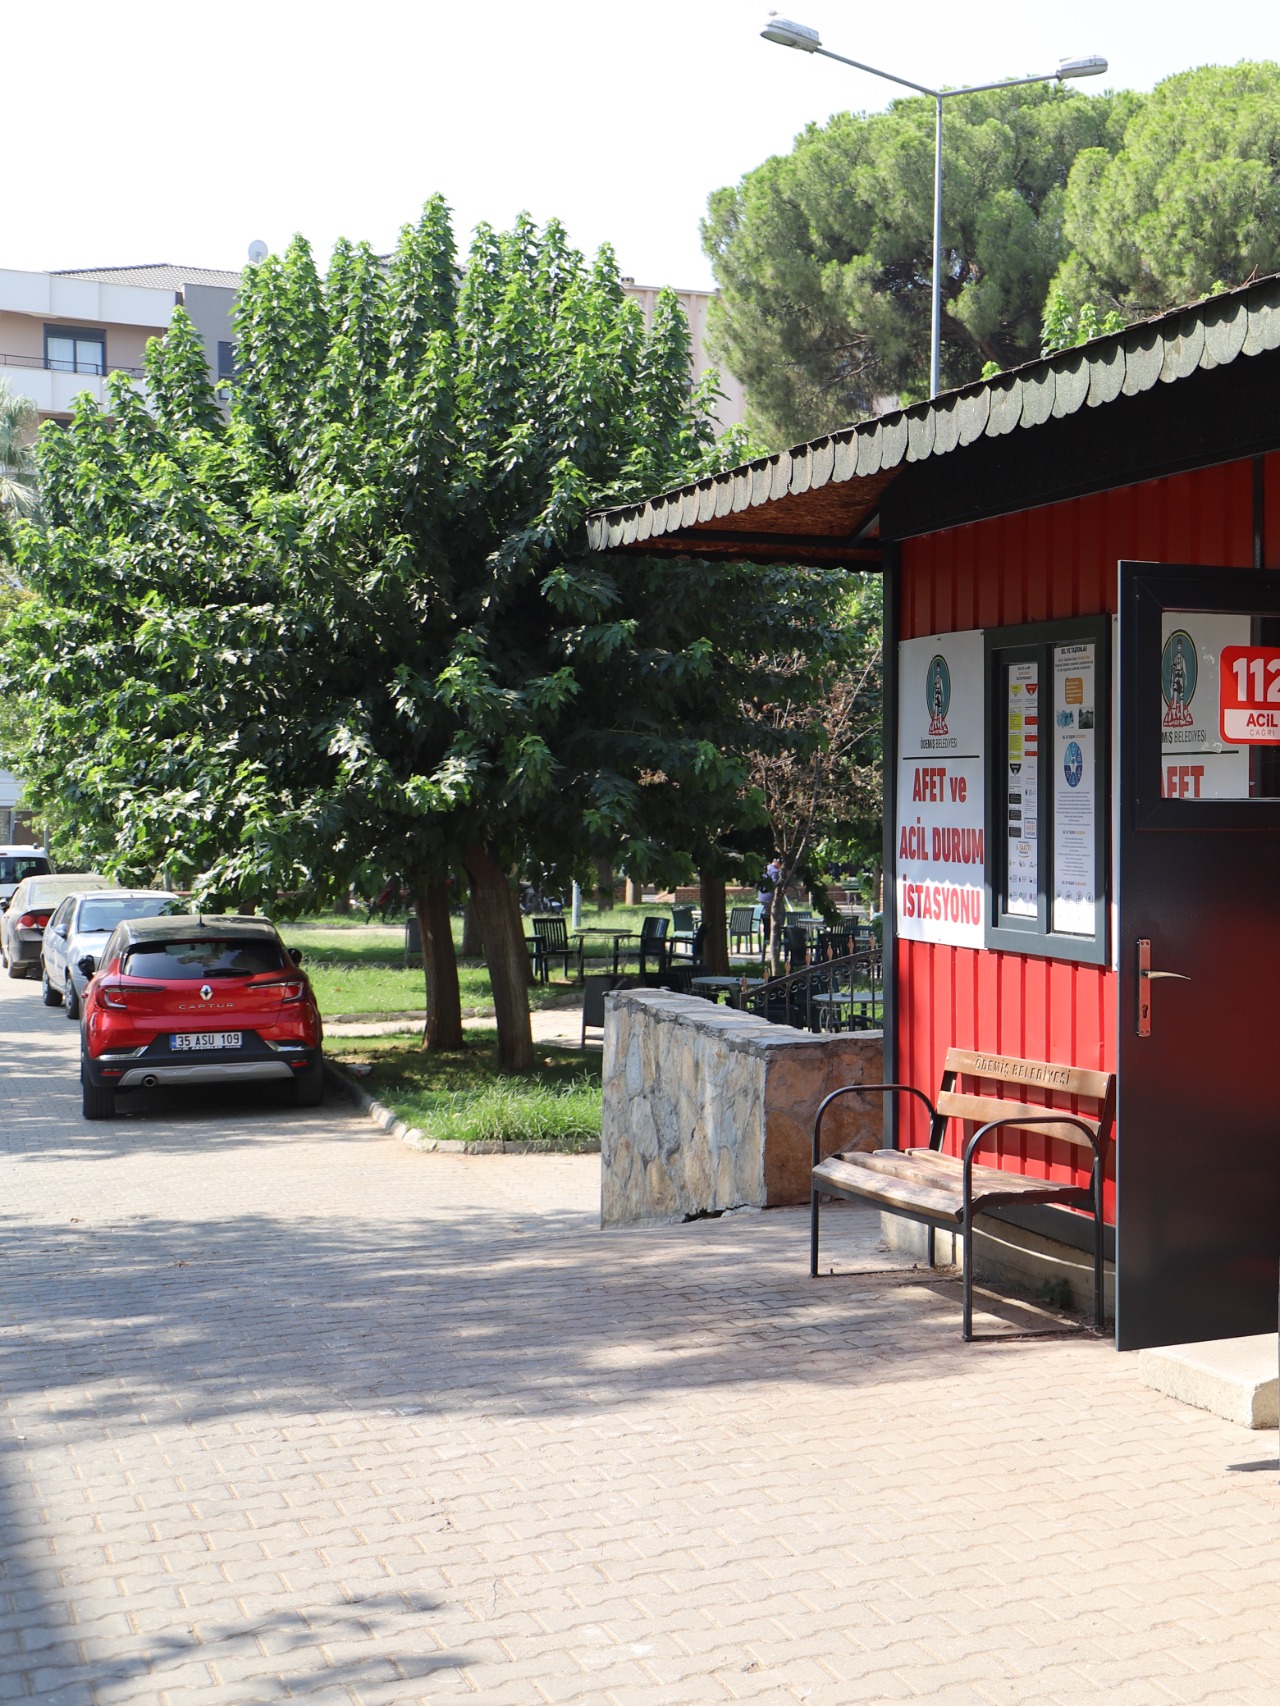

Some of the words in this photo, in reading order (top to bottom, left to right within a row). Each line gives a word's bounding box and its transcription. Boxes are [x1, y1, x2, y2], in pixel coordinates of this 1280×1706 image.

[1161, 731, 1173, 745] MİŞ
[912, 767, 946, 802] AFET
[949, 776, 967, 803] ve
[1161, 765, 1205, 798] FET
[899, 816, 928, 861] ACİL
[932, 827, 984, 865] DURUM
[902, 873, 980, 926] İSTASYONU
[178, 1002, 234, 1010] CAPTUR
[177, 1035, 191, 1047] 35
[195, 1034, 215, 1046] ASU
[221, 1033, 240, 1045] 109
